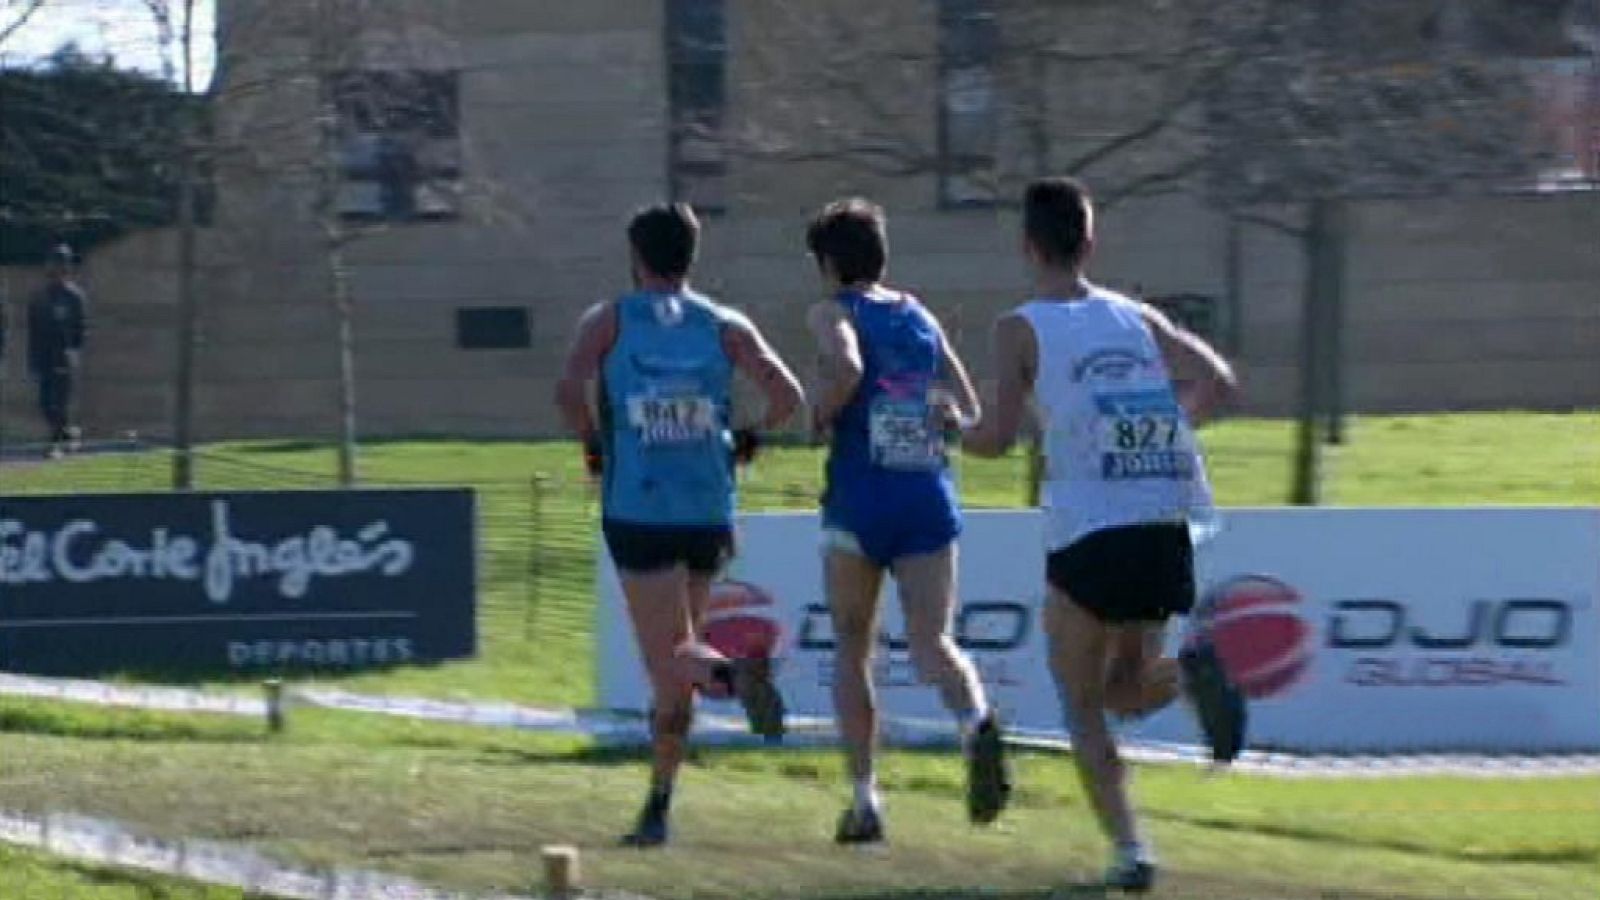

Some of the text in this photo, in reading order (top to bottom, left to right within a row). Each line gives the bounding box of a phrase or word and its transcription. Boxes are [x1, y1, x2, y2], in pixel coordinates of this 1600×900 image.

[1114, 419, 1176, 449] 827
[0, 499, 413, 602] El Corte Inglés
[1326, 599, 1573, 650] DJO
[228, 637, 413, 666] DEPORTES
